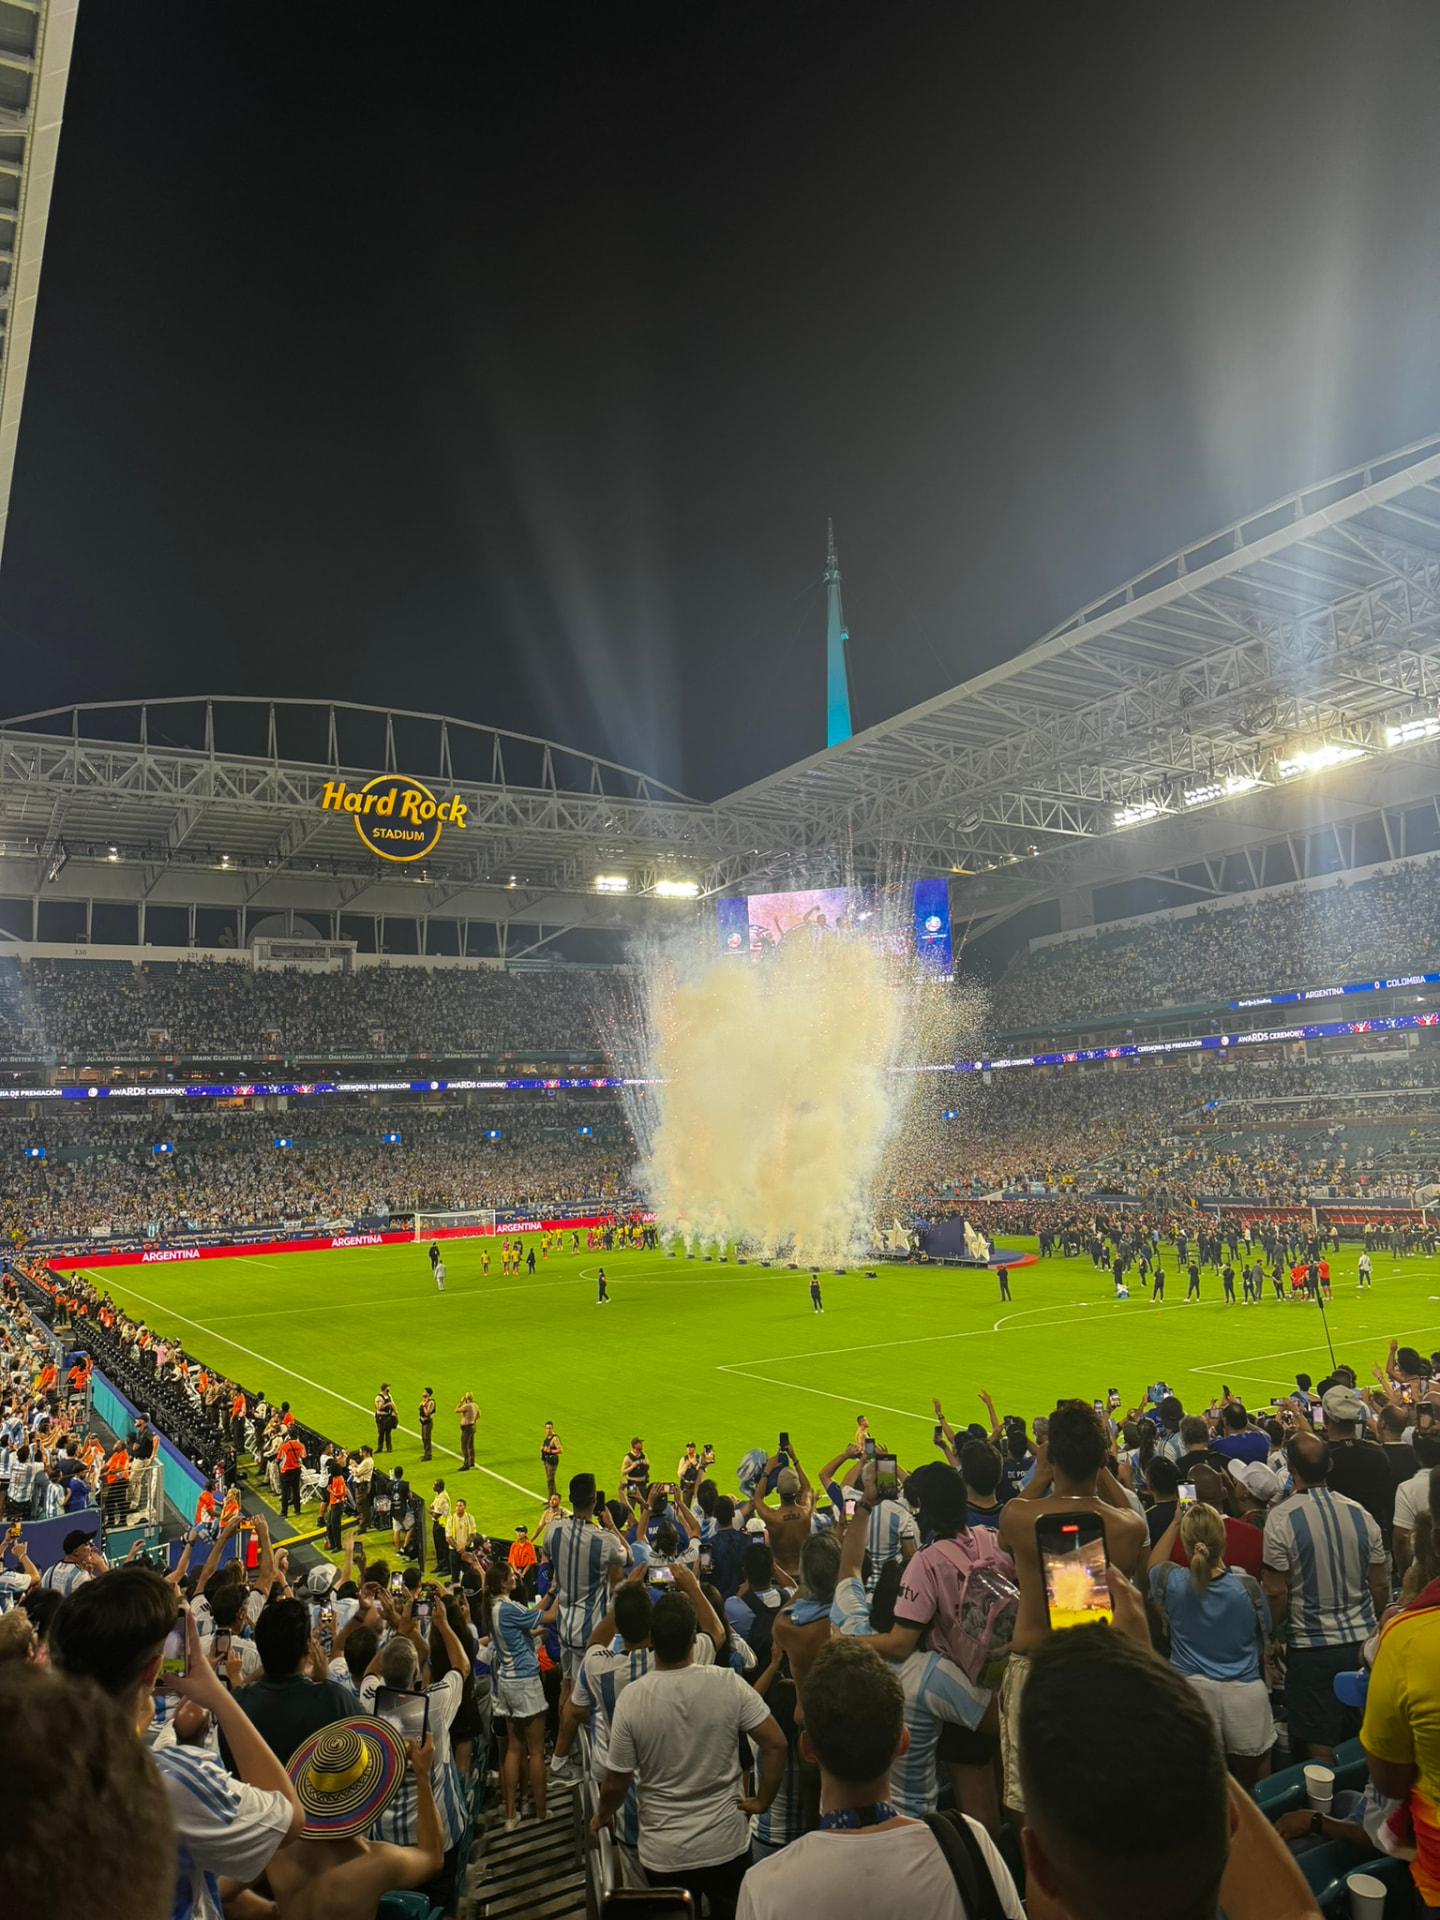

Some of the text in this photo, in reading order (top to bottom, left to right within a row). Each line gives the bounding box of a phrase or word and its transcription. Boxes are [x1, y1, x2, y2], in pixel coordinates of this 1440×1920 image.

[320, 780, 468, 829] Hard Rock
[371, 827, 425, 842] STADIUM
[73, 948, 87, 956] 330
[1386, 975, 1426, 988] COLOMBIA
[1297, 986, 1344, 1001] 1 ARGENTINA
[1237, 1032, 1269, 1043] AWARDS
[109, 1086, 147, 1096] AWARDS
[446, 1081, 476, 1089] AWARDS
[496, 1221, 542, 1233] ARGENTINA
[331, 1234, 383, 1248] ARGENTINA
[141, 1248, 200, 1263] ARGENTINA
